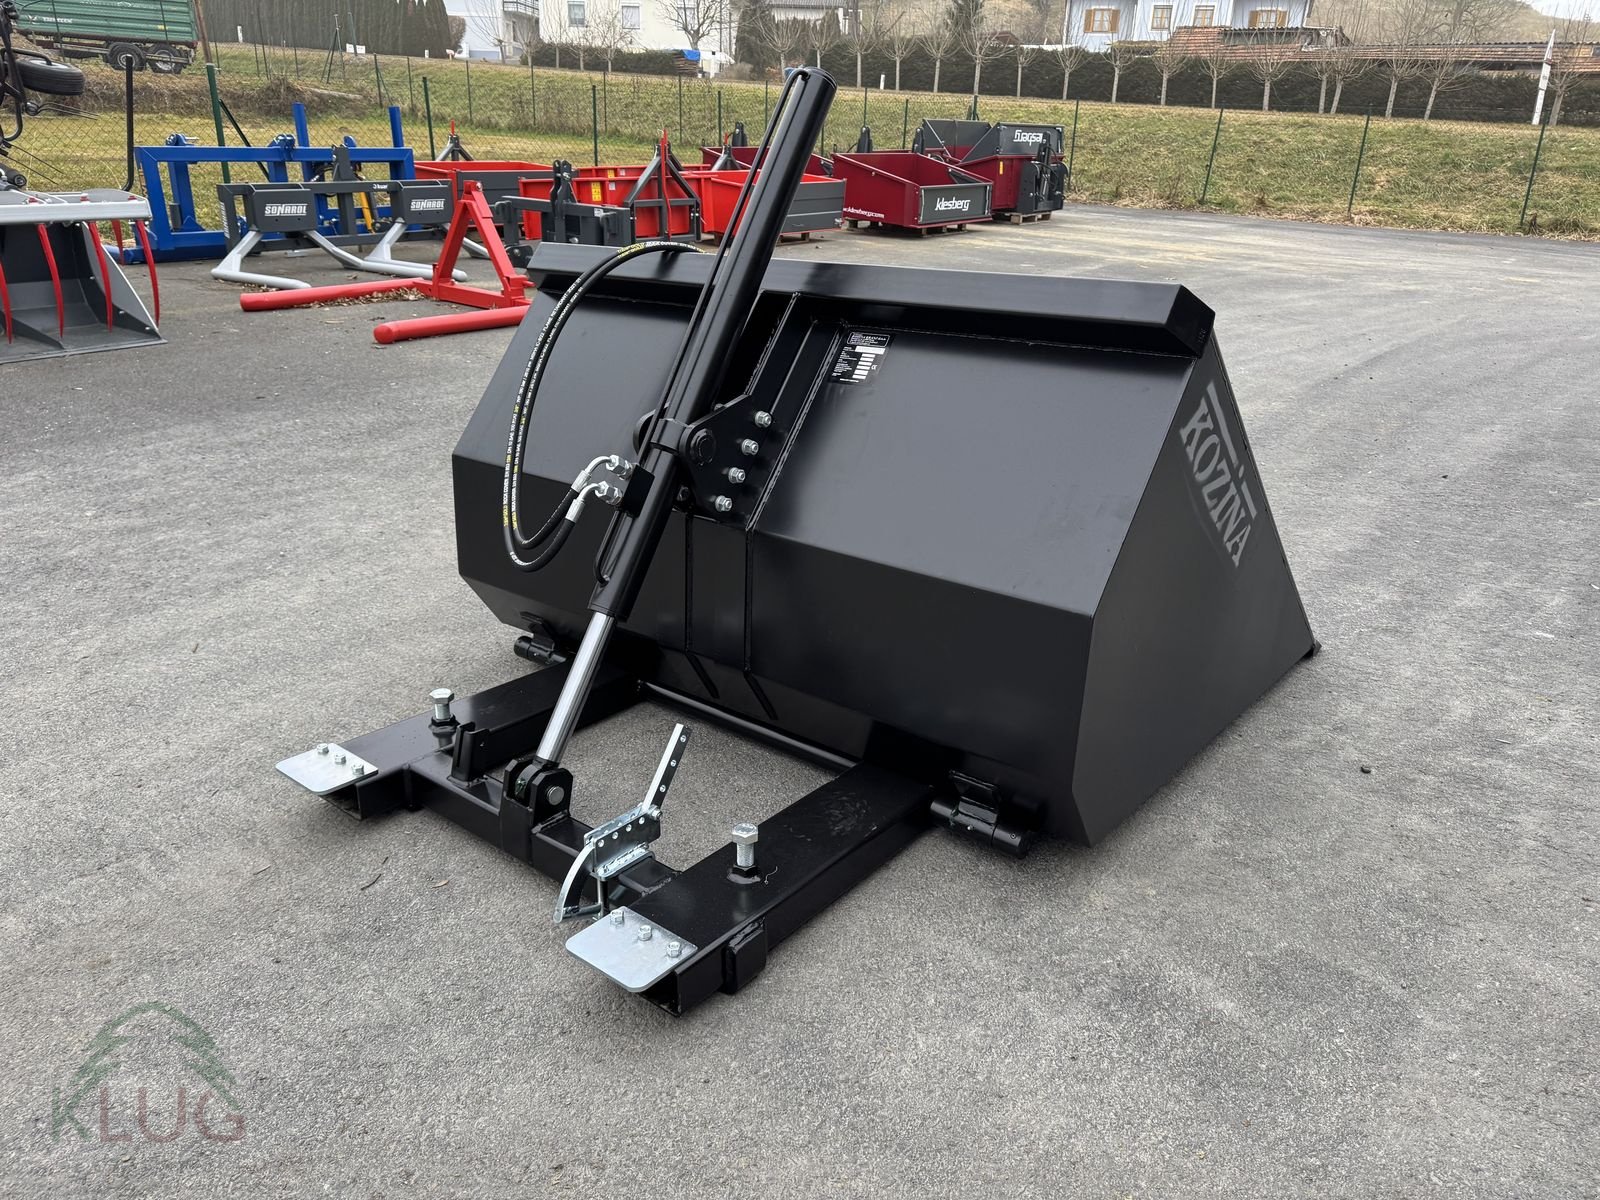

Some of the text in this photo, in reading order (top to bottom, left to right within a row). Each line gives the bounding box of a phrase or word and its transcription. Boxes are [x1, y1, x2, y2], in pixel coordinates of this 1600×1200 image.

[1012, 129, 1044, 147] lesberg
[264, 203, 308, 217] SONAROL
[410, 198, 446, 211] SONAROL
[934, 196, 971, 212] klesberg
[1179, 393, 1252, 568] KOZINA
